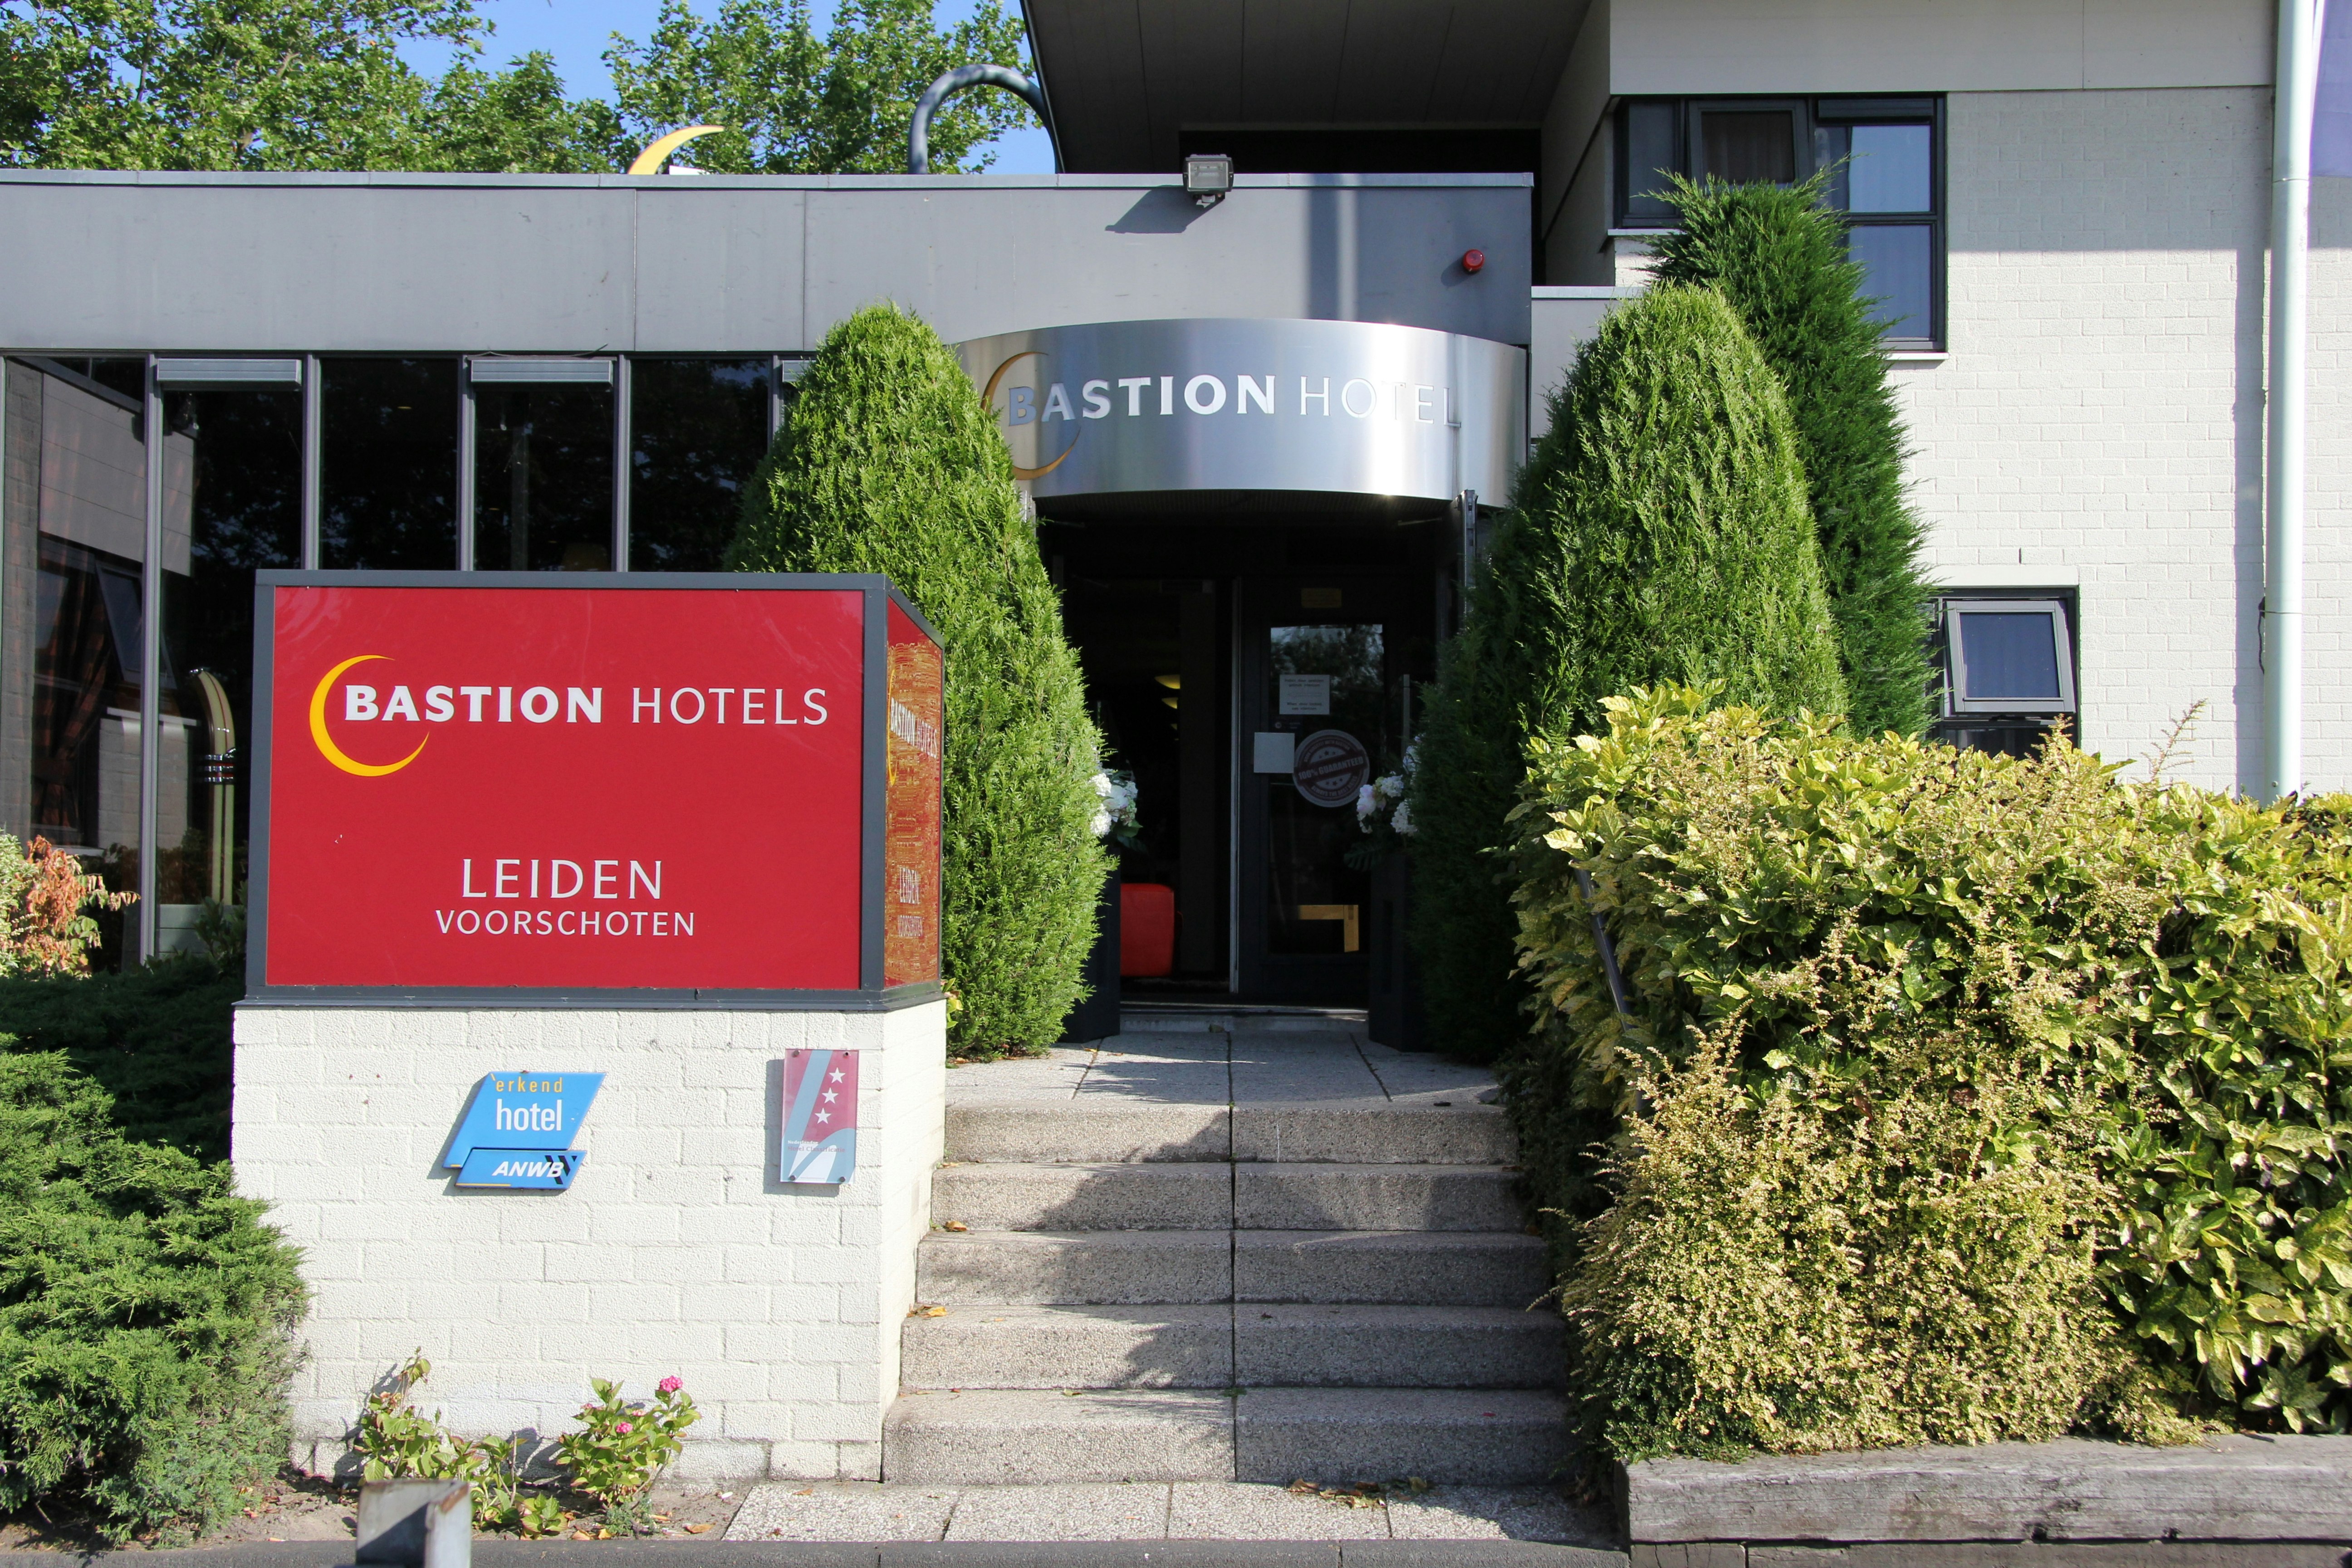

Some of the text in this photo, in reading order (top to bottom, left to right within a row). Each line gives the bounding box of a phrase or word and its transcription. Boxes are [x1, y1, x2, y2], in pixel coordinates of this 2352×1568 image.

[1009, 374, 1461, 428] BASTION HOTEL
[345, 685, 828, 725] BASTION HOTELS
[891, 697, 916, 747] BASTION
[1298, 756, 1364, 780] 100% GUARANTEED
[462, 858, 662, 899] LEIDEN
[436, 910, 694, 936] VOORSCHOTEN
[496, 1076, 563, 1093] erkend
[496, 1098, 562, 1131] hotel
[492, 1161, 564, 1177] ANWB
